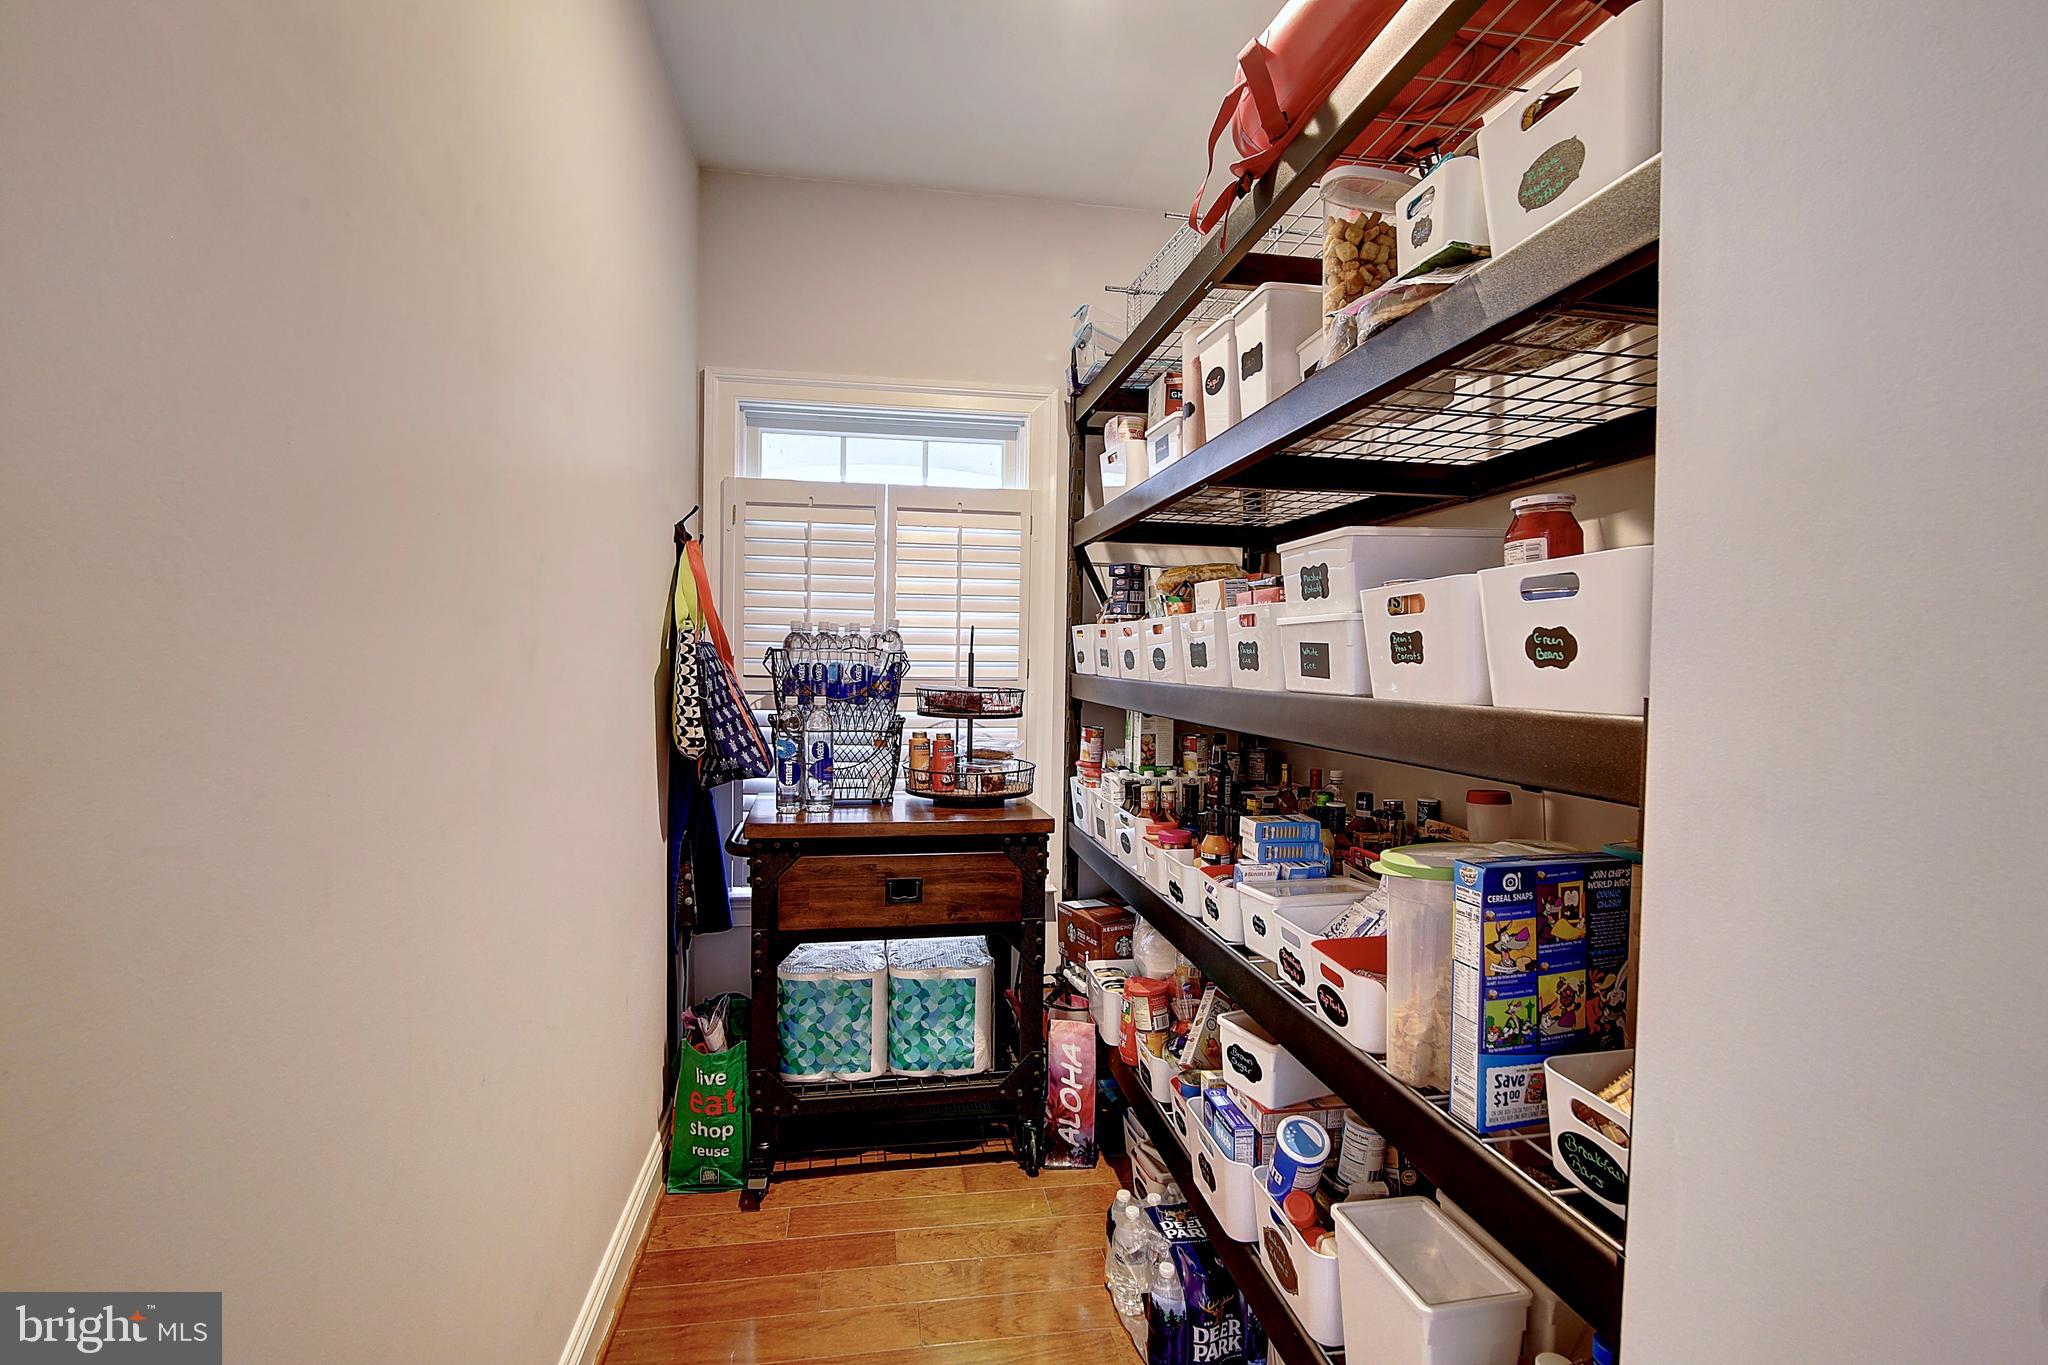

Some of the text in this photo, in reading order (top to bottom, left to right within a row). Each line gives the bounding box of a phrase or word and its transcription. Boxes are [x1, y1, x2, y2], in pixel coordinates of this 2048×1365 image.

[1533, 633, 1564, 646] Green
[1535, 647, 1564, 660] Beans
[817, 741, 825, 760] water
[785, 760, 793, 786] smart
[1590, 868, 1631, 880] JOIN CHIP'S
[1587, 878, 1631, 890] WORLD WIDE
[1487, 892, 1534, 903] CEREAL SNAPS
[1230, 1046, 1253, 1066] Brown
[1231, 1056, 1252, 1075] Sugar
[695, 1066, 727, 1086] live
[1494, 1073, 1526, 1089] Save
[689, 1088, 737, 1117] eat
[1057, 1042, 1084, 1148] ALOHA
[689, 1120, 735, 1142] shop
[692, 1145, 730, 1158] reuse
[1568, 1153, 1604, 1188] Bars
[1192, 1319, 1242, 1344] DEER
[1193, 1335, 1242, 1363] PARK
